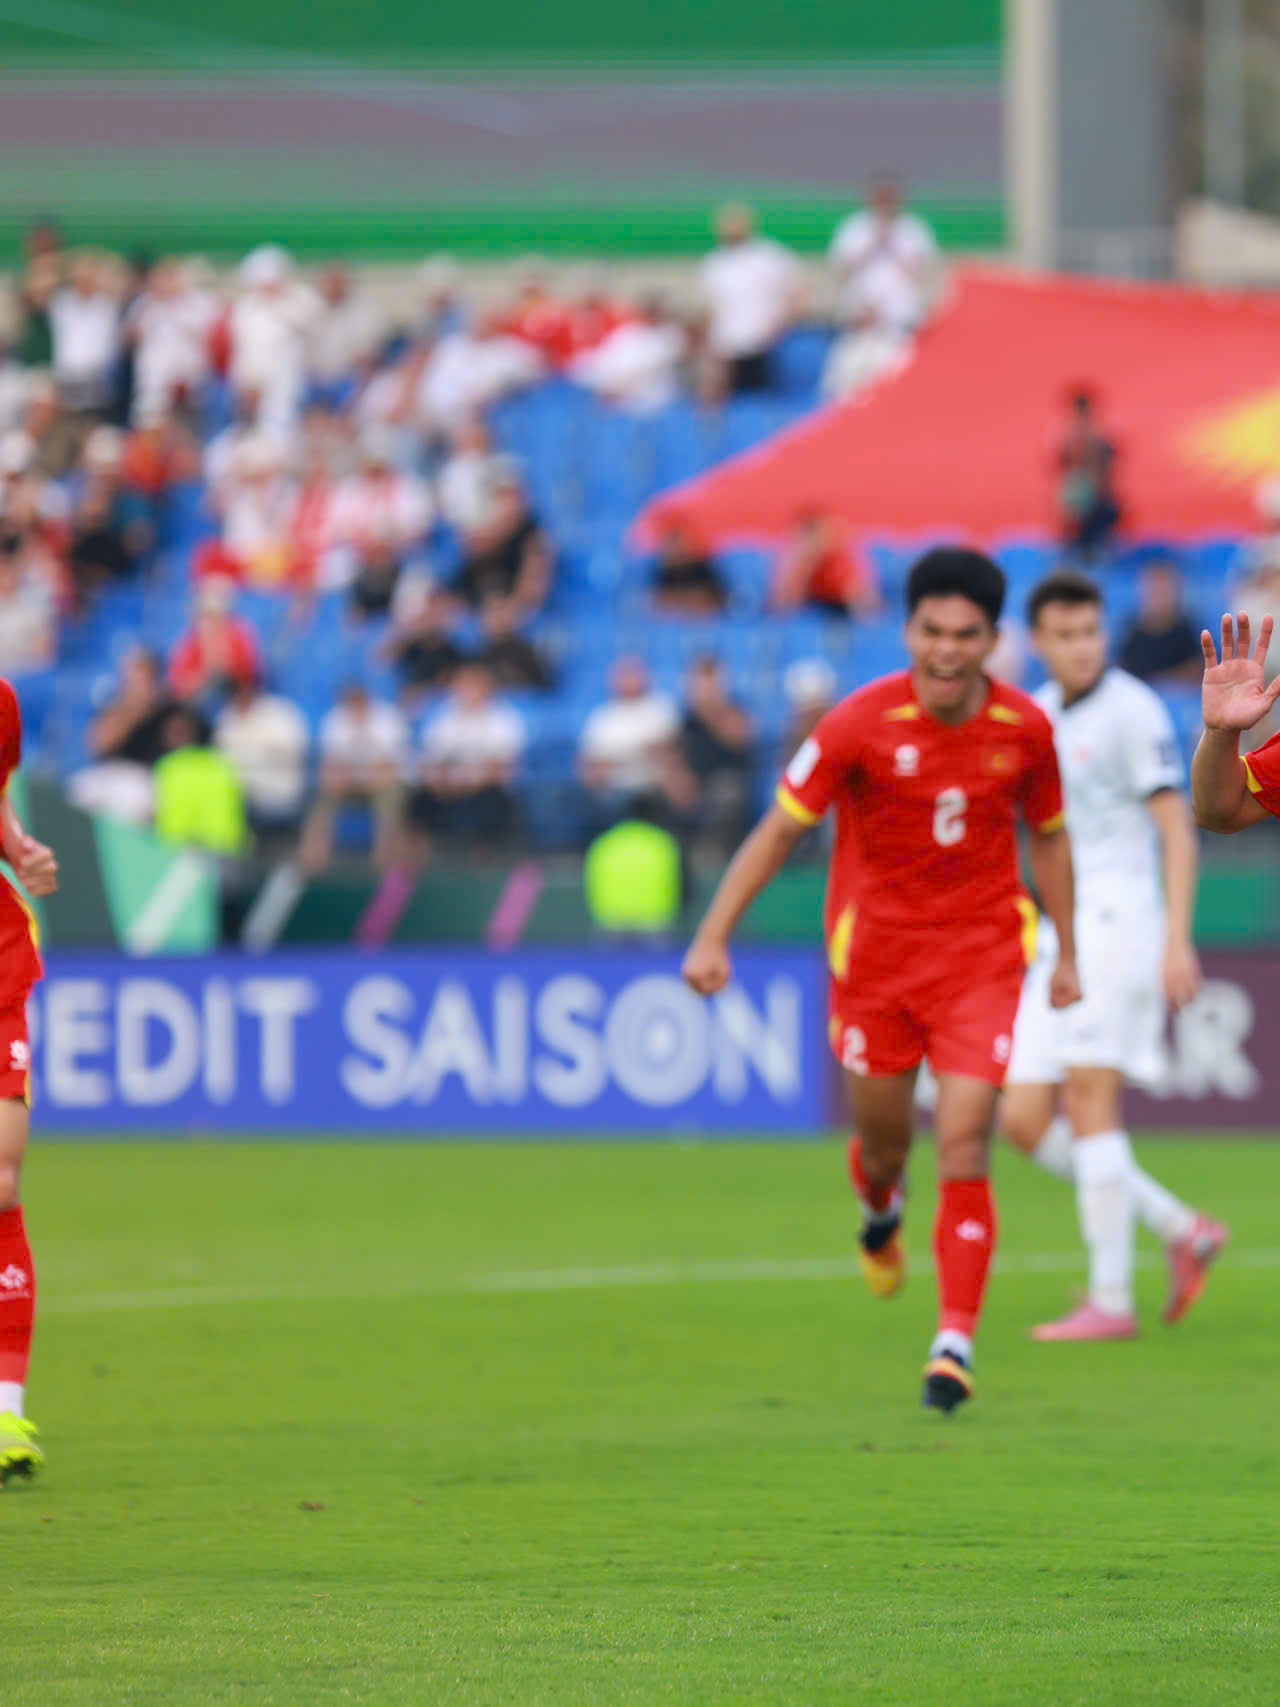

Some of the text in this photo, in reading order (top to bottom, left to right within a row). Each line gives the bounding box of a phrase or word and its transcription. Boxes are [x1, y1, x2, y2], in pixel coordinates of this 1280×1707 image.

[932, 786, 967, 847] 2
[27, 973, 800, 1109] EDIT SAISON
